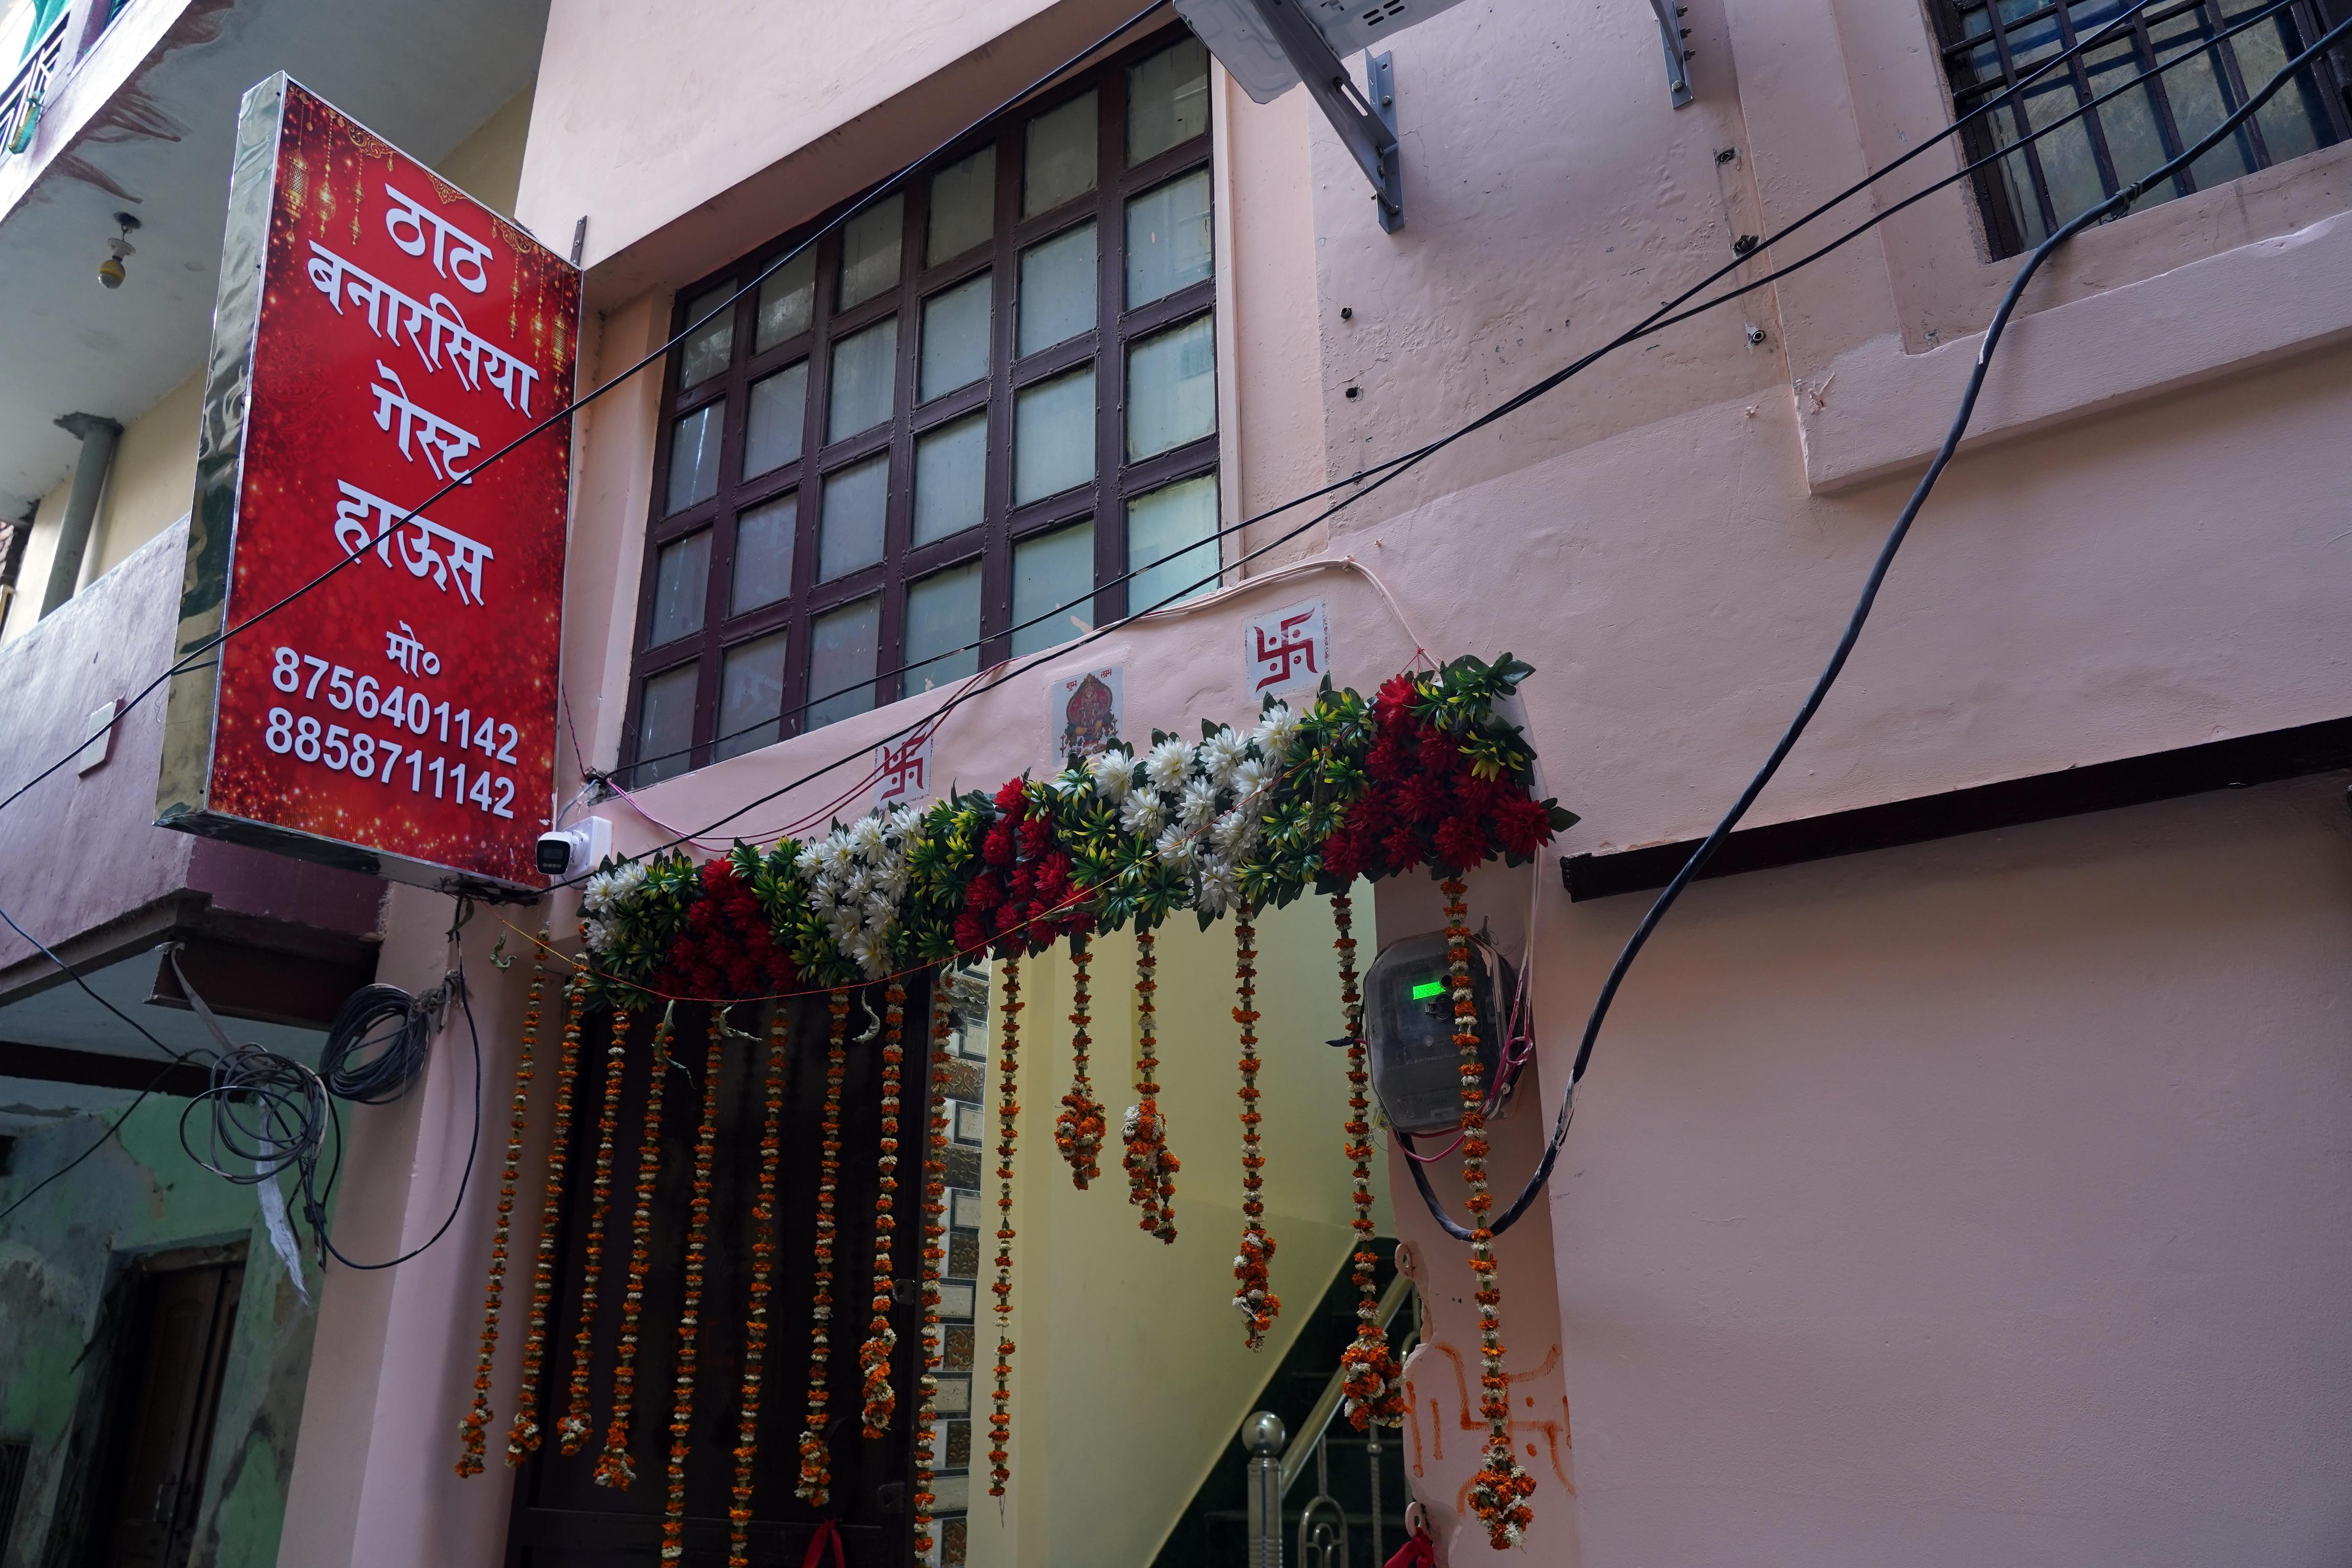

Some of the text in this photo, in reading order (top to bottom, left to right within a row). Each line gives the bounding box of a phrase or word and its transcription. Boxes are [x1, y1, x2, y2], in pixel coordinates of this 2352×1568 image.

[385, 183, 493, 293] ठाठ
[308, 240, 539, 419] बनारसिया
[371, 360, 481, 484] गेस्ट
[335, 479, 494, 606] हाऊस
[272, 647, 518, 765] 8756401142
[1066, 668, 1112, 691] शुभ लाभ
[266, 707, 514, 818] 8858711142
